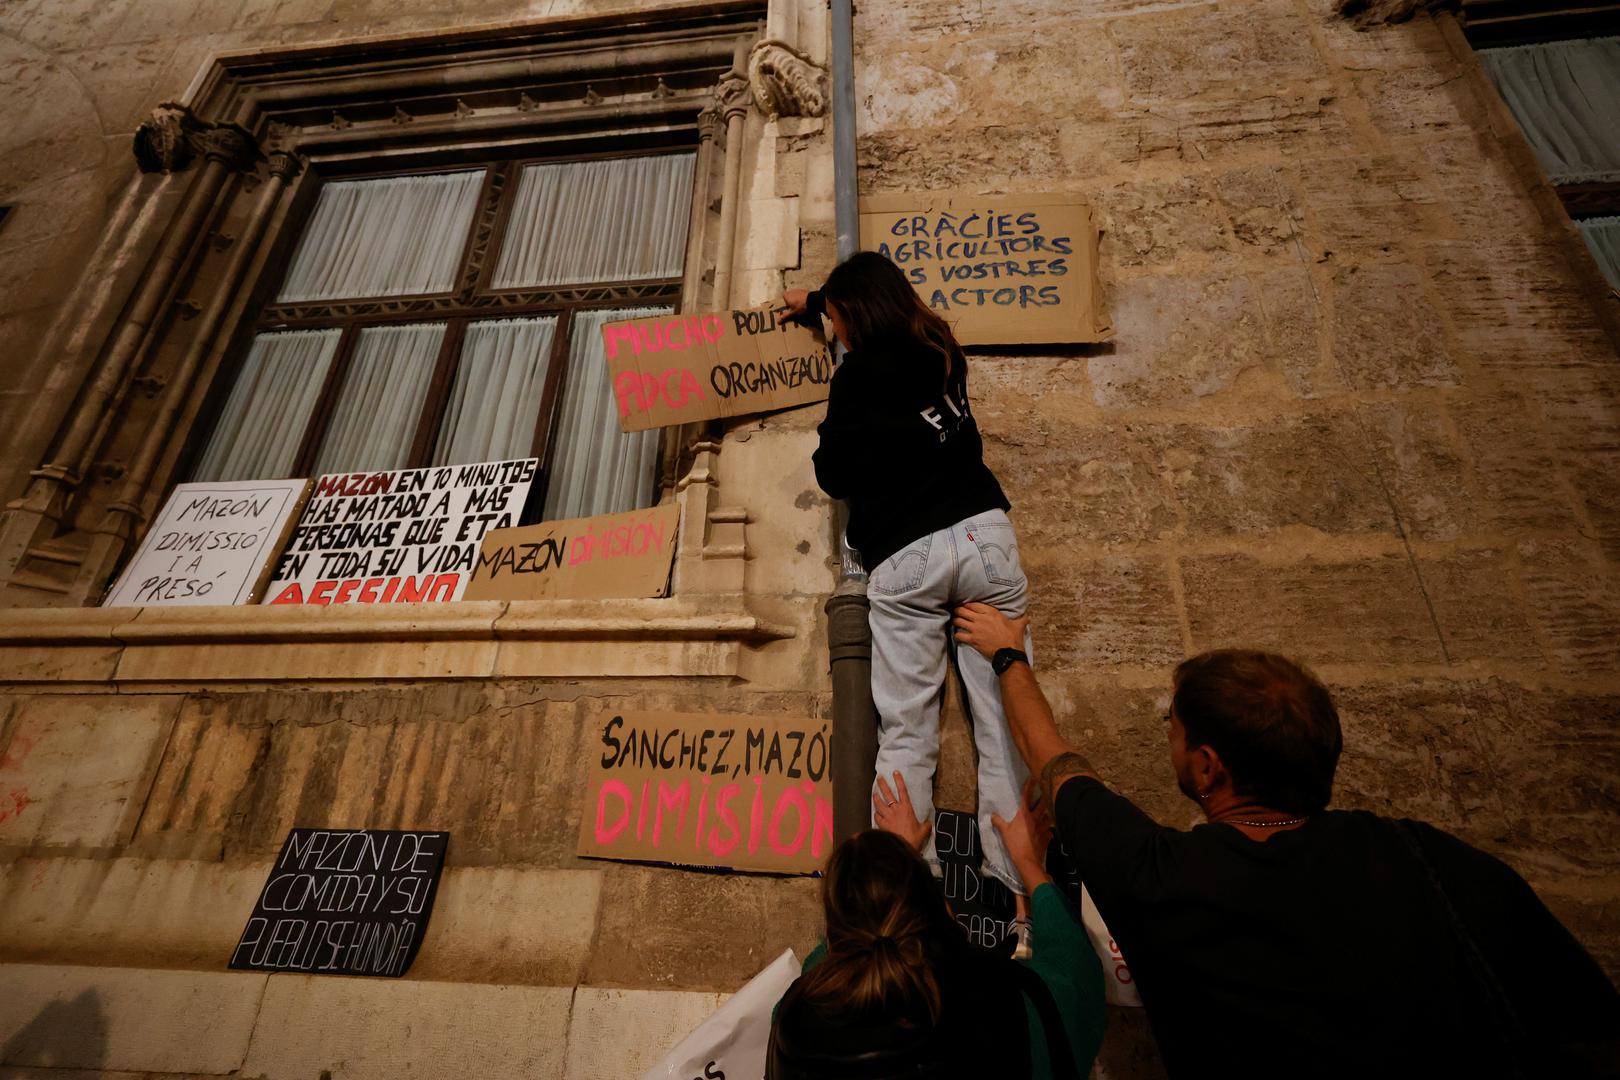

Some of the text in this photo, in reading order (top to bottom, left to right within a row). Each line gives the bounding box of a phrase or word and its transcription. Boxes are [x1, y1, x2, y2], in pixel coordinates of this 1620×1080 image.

[878, 236, 1073, 263] AGRICULTORS
[941, 258, 1068, 282] VOSTRES
[929, 285, 1061, 310] ACTORS
[605, 314, 726, 359] MUCHO
[710, 347, 831, 399] ORGANIZACIÓ
[394, 468, 430, 493] EN
[432, 468, 452, 490] 10
[454, 460, 537, 488] MINUTOS
[176, 493, 272, 522] MAZÓN
[300, 498, 346, 524] HAS
[342, 493, 432, 522] MATADO
[429, 491, 451, 516] A
[154, 526, 267, 551] DIMISSIÓ
[296, 513, 512, 551] PERSONAS QUE ETA
[185, 555, 203, 574] A
[274, 544, 476, 581] EN TODA SU VIDA
[471, 530, 567, 582] MAZÓN
[133, 570, 227, 603] PRESÓ
[280, 829, 441, 874] MAZÓN DE
[262, 873, 433, 915] COMIDA Y SU
[231, 917, 330, 970] PUEBLO
[317, 920, 356, 970] SE
